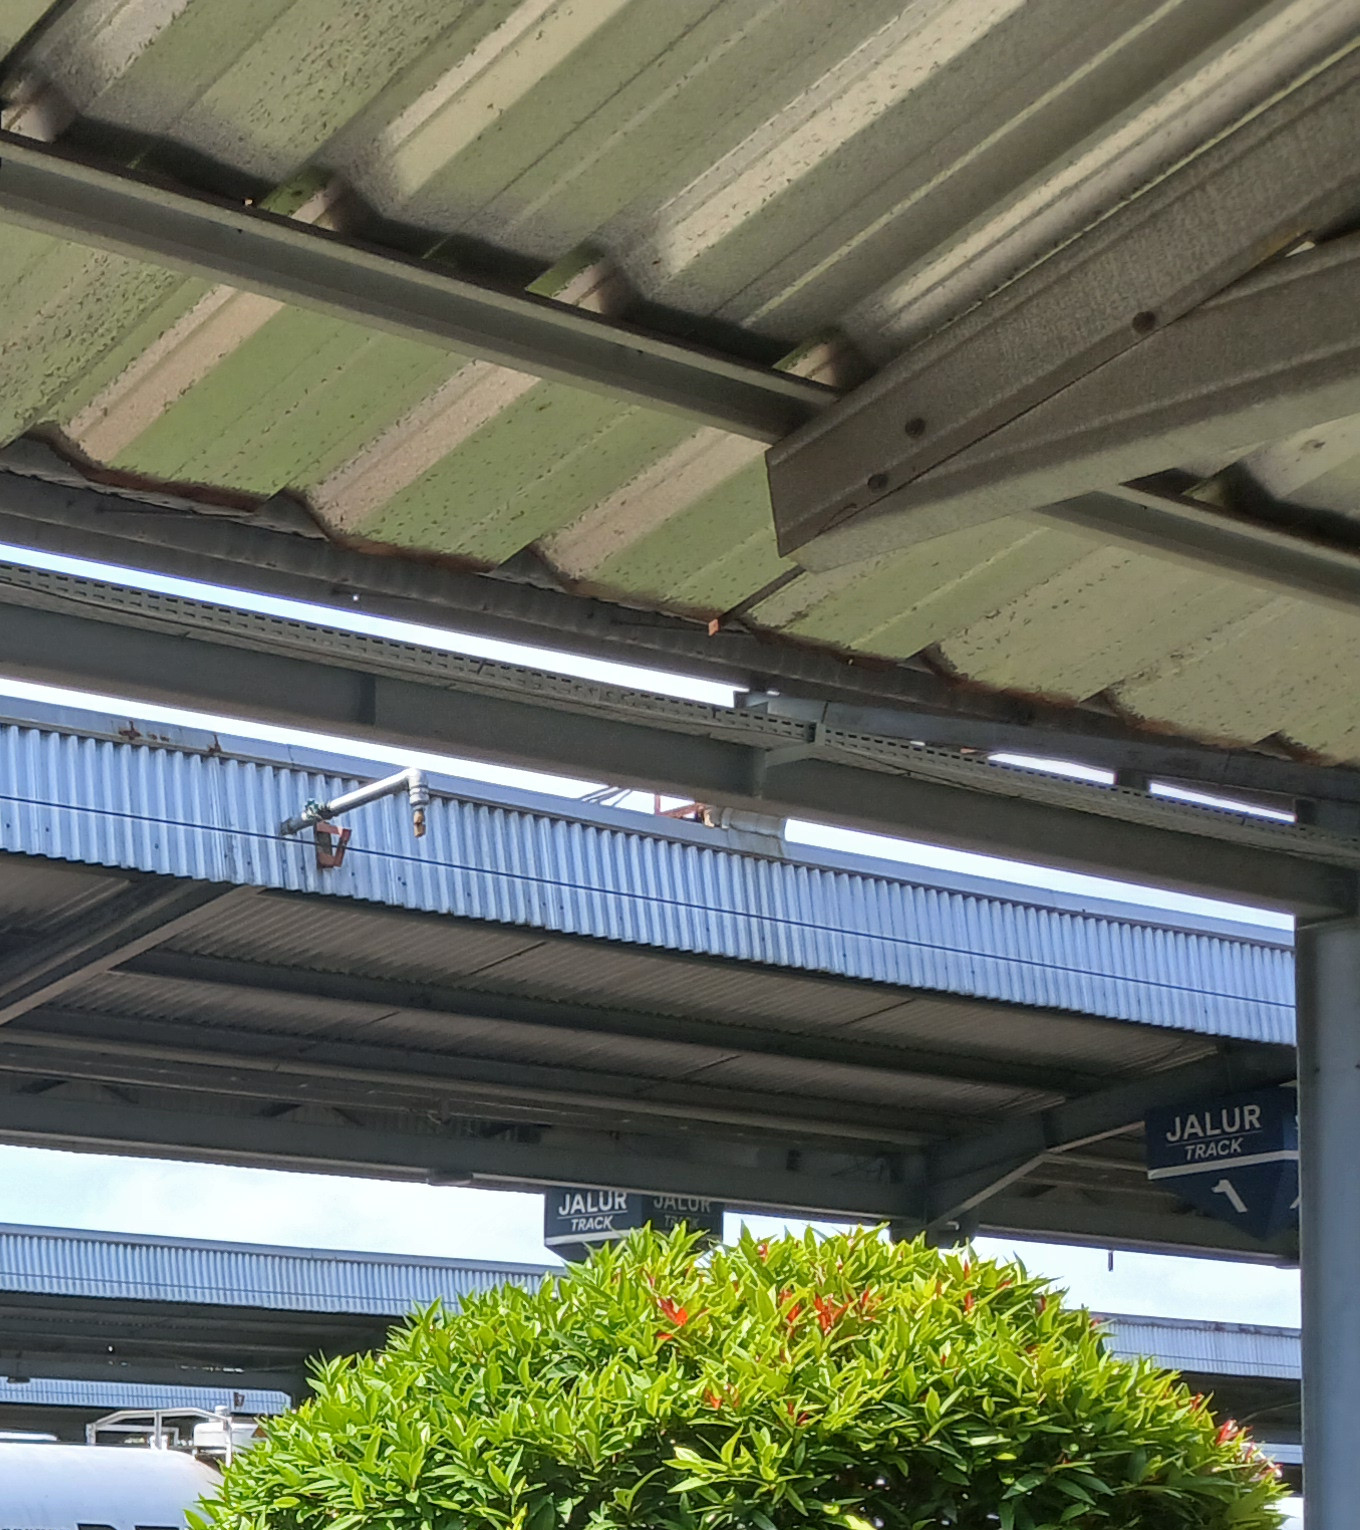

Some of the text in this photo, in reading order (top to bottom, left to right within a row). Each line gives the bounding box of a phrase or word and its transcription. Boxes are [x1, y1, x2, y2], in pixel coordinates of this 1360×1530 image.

[1166, 1104, 1262, 1142] JALUR
[1184, 1137, 1244, 1161] TRACK
[558, 1191, 628, 1216] JALUR
[1211, 1179, 1248, 1213] 1
[571, 1215, 614, 1232] TRACK
